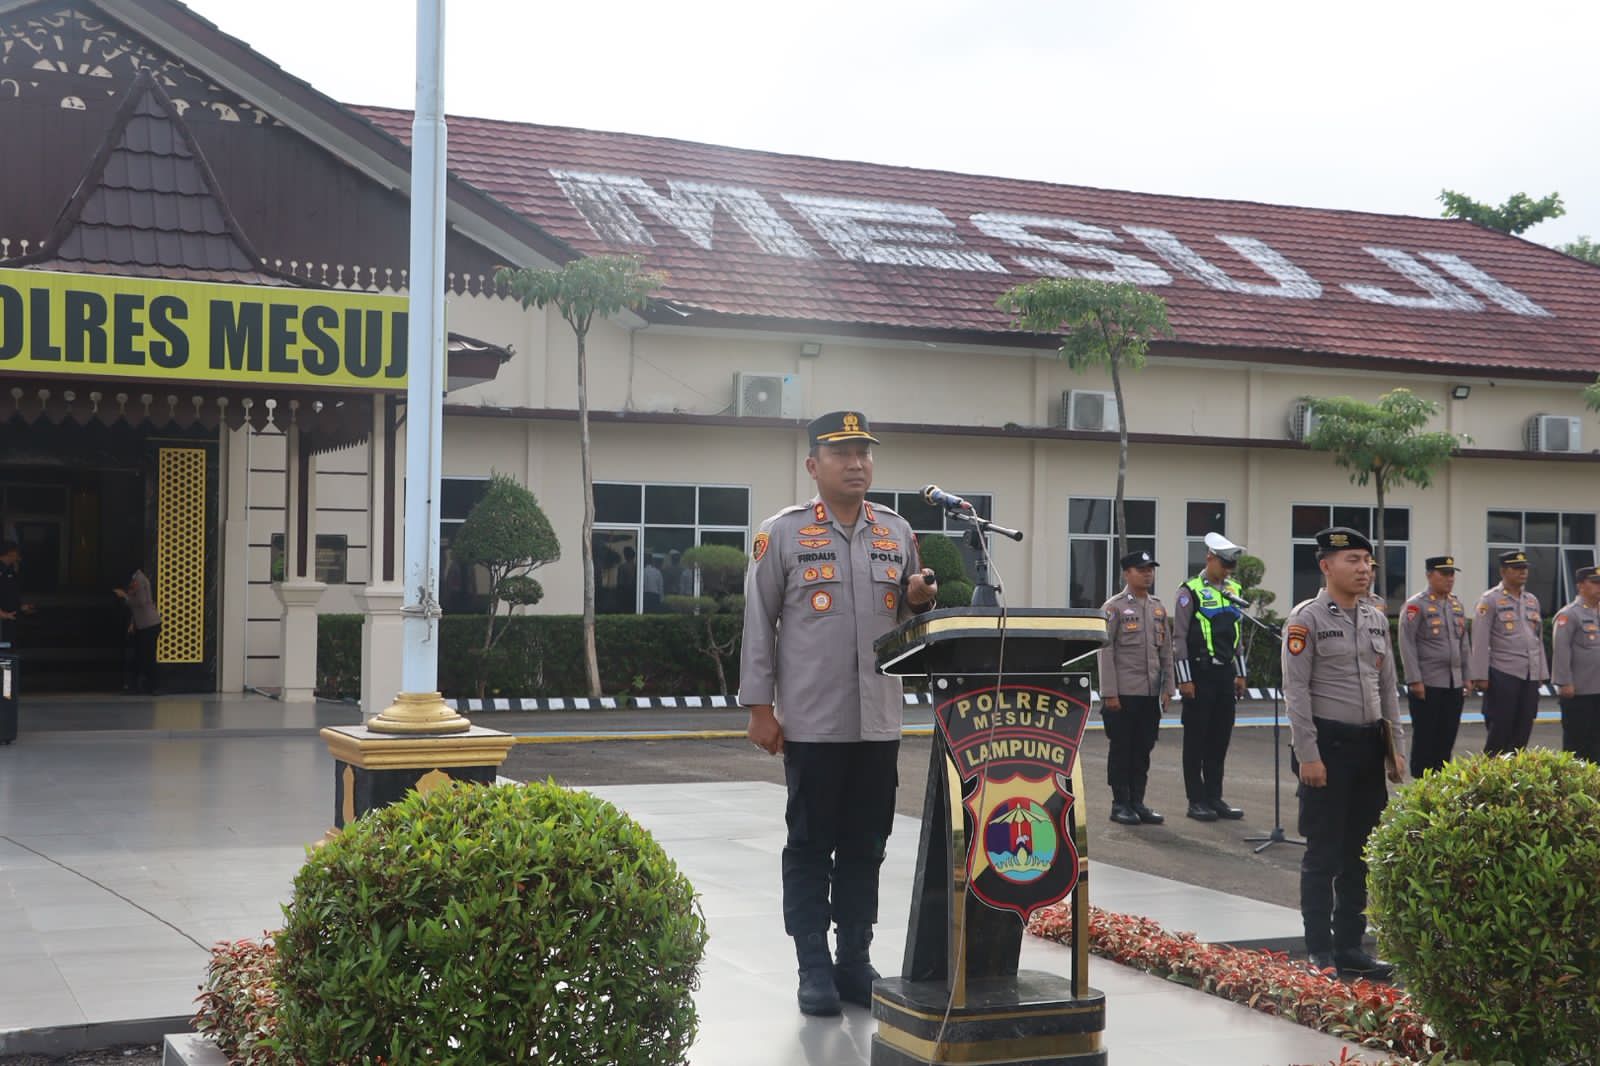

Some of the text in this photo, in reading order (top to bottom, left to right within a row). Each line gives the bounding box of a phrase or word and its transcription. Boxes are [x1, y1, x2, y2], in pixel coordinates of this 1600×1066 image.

[549, 168, 1556, 317] MESUJI
[798, 552, 836, 563] FIRDAUS
[957, 692, 1069, 719] POLRES
[973, 711, 1054, 730] MESUJI
[966, 739, 1065, 767] LAMPUNG
